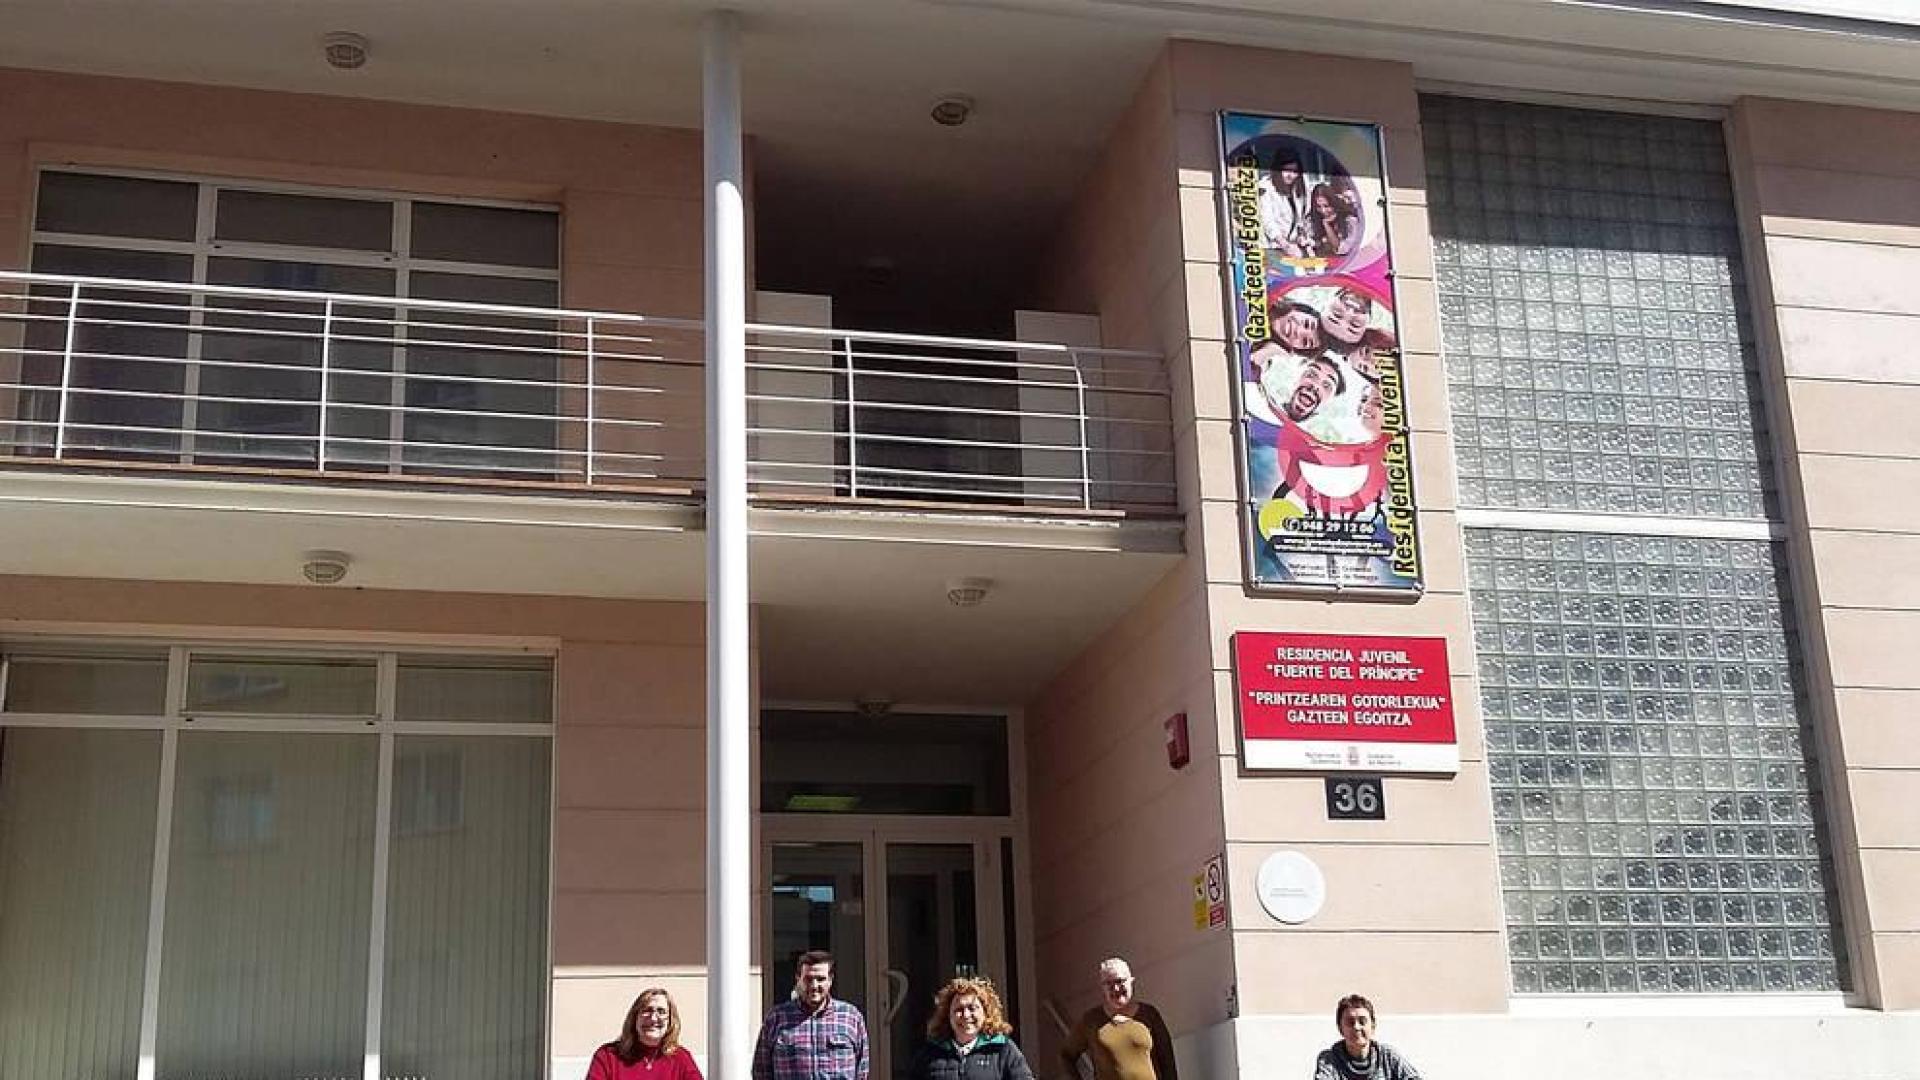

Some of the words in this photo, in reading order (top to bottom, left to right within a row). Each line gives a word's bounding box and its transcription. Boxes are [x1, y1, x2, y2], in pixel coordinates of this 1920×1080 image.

[1243, 251, 1267, 342] Gazteen
[1384, 443, 1415, 573] Residencia
[1277, 648, 1354, 663] RESIDENCIA
[1359, 650, 1411, 664] JUVENIL
[1266, 664, 1324, 680] "FUERTE
[1329, 666, 1354, 680] DEL
[1249, 692, 1347, 707] "PRINTZEAREN
[1352, 695, 1445, 710] GOTORLEKUA"
[1287, 710, 1349, 724] GAZTEEN
[1354, 712, 1413, 726] EGOITZA
[1335, 783, 1378, 813] 36
